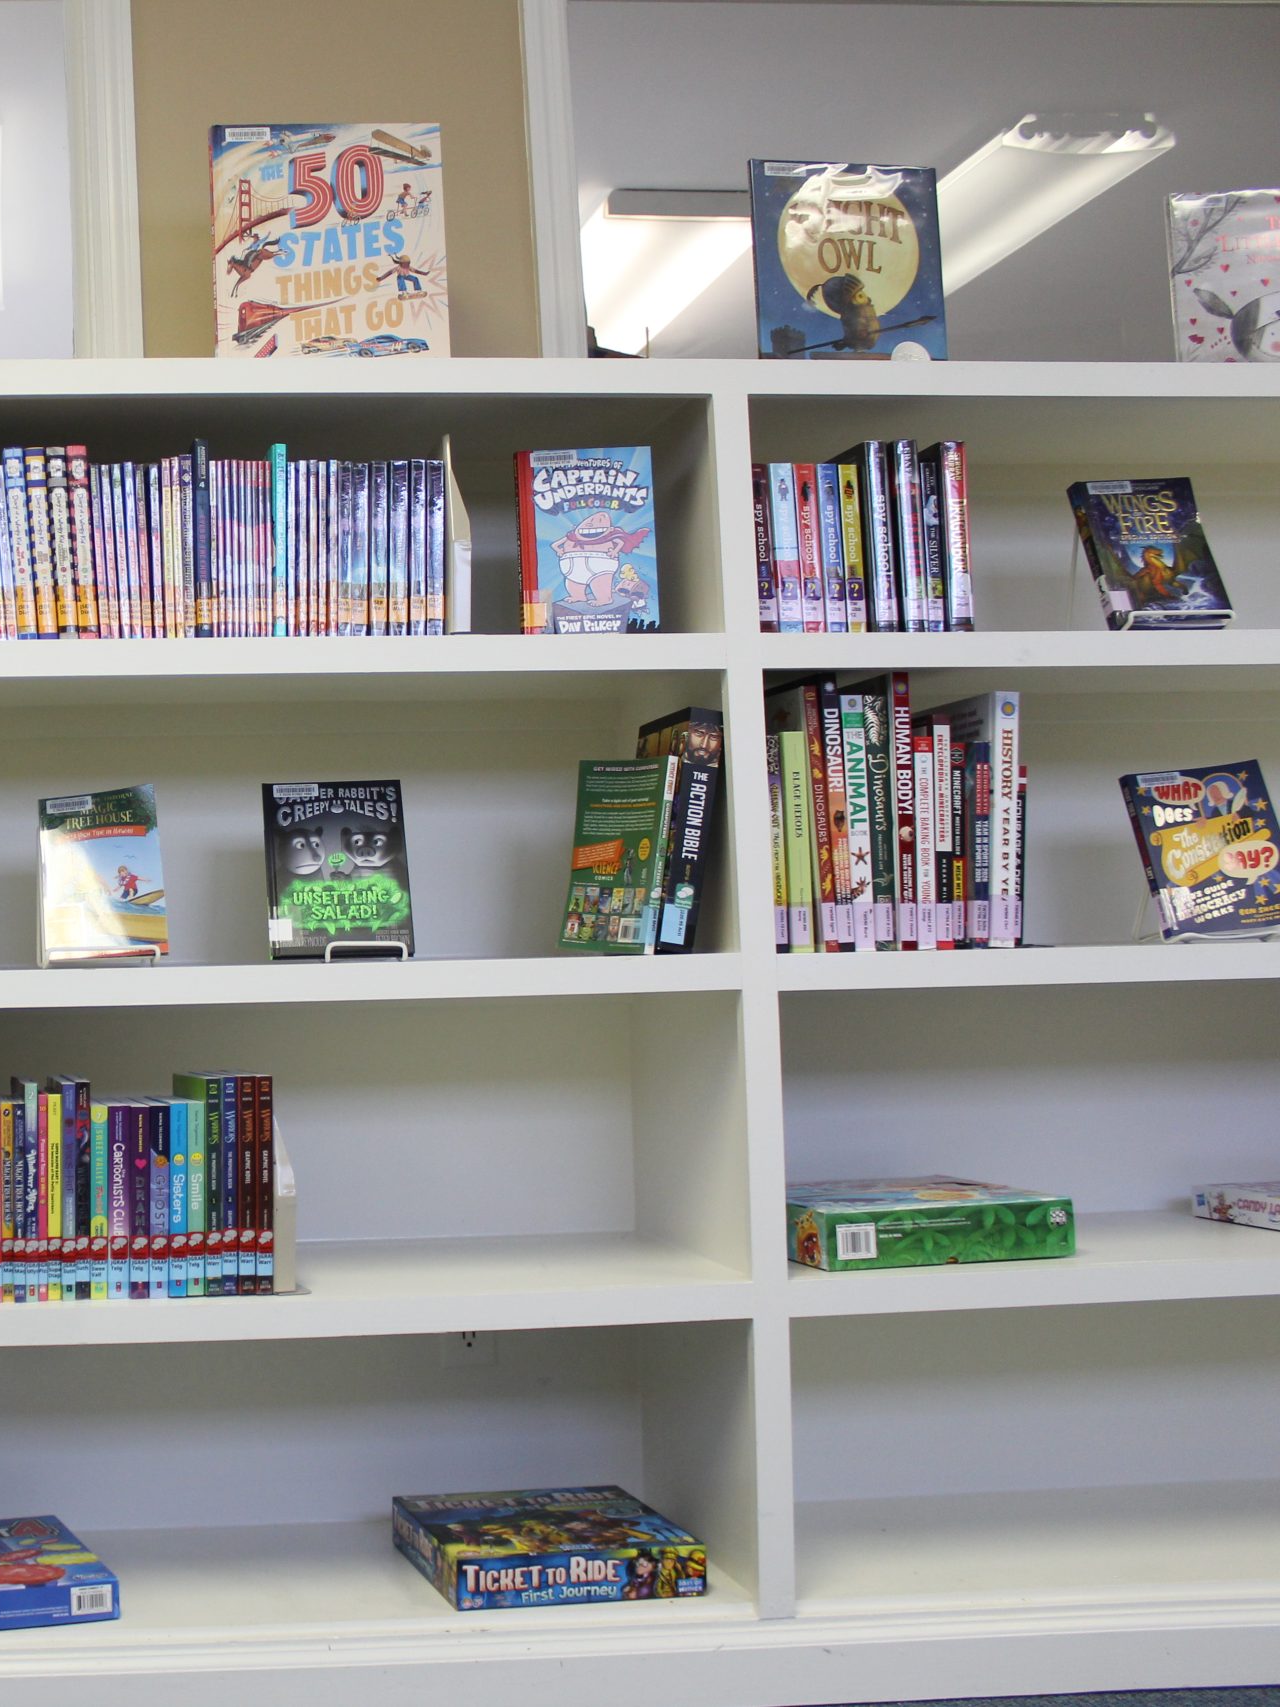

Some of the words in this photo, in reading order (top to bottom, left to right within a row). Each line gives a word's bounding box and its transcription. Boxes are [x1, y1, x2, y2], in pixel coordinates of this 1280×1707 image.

[258, 163, 284, 182] THE
[288, 144, 385, 229] 50
[272, 218, 405, 268] STATES
[818, 238, 882, 274] OWL
[275, 262, 380, 305] THINGS
[289, 304, 356, 342] THAT
[365, 299, 404, 331] GO
[534, 483, 648, 510] UNDERPANTS
[563, 500, 586, 512] FULL
[588, 498, 620, 510] COLOR
[876, 494, 886, 522] spy
[1101, 491, 1177, 514] WINGS
[755, 504, 763, 525] spy
[846, 505, 854, 525] spy
[1120, 513, 1173, 534] FIRE
[758, 527, 768, 562] school
[828, 528, 839, 563] school
[848, 527, 859, 563] school
[878, 526, 892, 577] school
[929, 541, 938, 573] SILVER
[559, 621, 581, 633] DAV
[824, 708, 844, 793] DINOSAUR!
[895, 707, 911, 765] HUMAN
[693, 771, 709, 781] THE
[1001, 728, 1013, 800] HISTORY
[338, 787, 396, 801] RABBIT'S
[846, 741, 868, 829] ANIMAL
[867, 753, 887, 831] Dinosaurs
[897, 770, 913, 815] BODY!
[919, 778, 929, 813] COMPLETE
[952, 770, 961, 814] MINECRAFT
[1153, 781, 1203, 800] WHAT
[64, 816, 92, 830] TREE
[96, 810, 133, 825] HOUSE
[276, 801, 329, 826] CREEPY
[344, 799, 397, 823] TALES!
[687, 783, 707, 826] ACTION
[814, 784, 828, 843] DINOSAURS
[1153, 804, 1194, 827] DOES
[1002, 807, 1010, 846] YEAR
[1173, 827, 1199, 848] The
[682, 828, 701, 860] BIBLE
[921, 847, 929, 869] BOOK
[1002, 853, 1009, 871] BY
[293, 890, 389, 905] UNSETTLING
[921, 881, 931, 904] YOUNG
[311, 905, 378, 920] SALAD!
[173, 1174, 184, 1223] Sisters
[191, 1173, 203, 1210] Smile
[462, 1564, 544, 1593] TICKET
[545, 1567, 566, 1585] TO
[569, 1555, 623, 1583] RIDE
[521, 1590, 554, 1605] First
[559, 1585, 617, 1600] Journey
